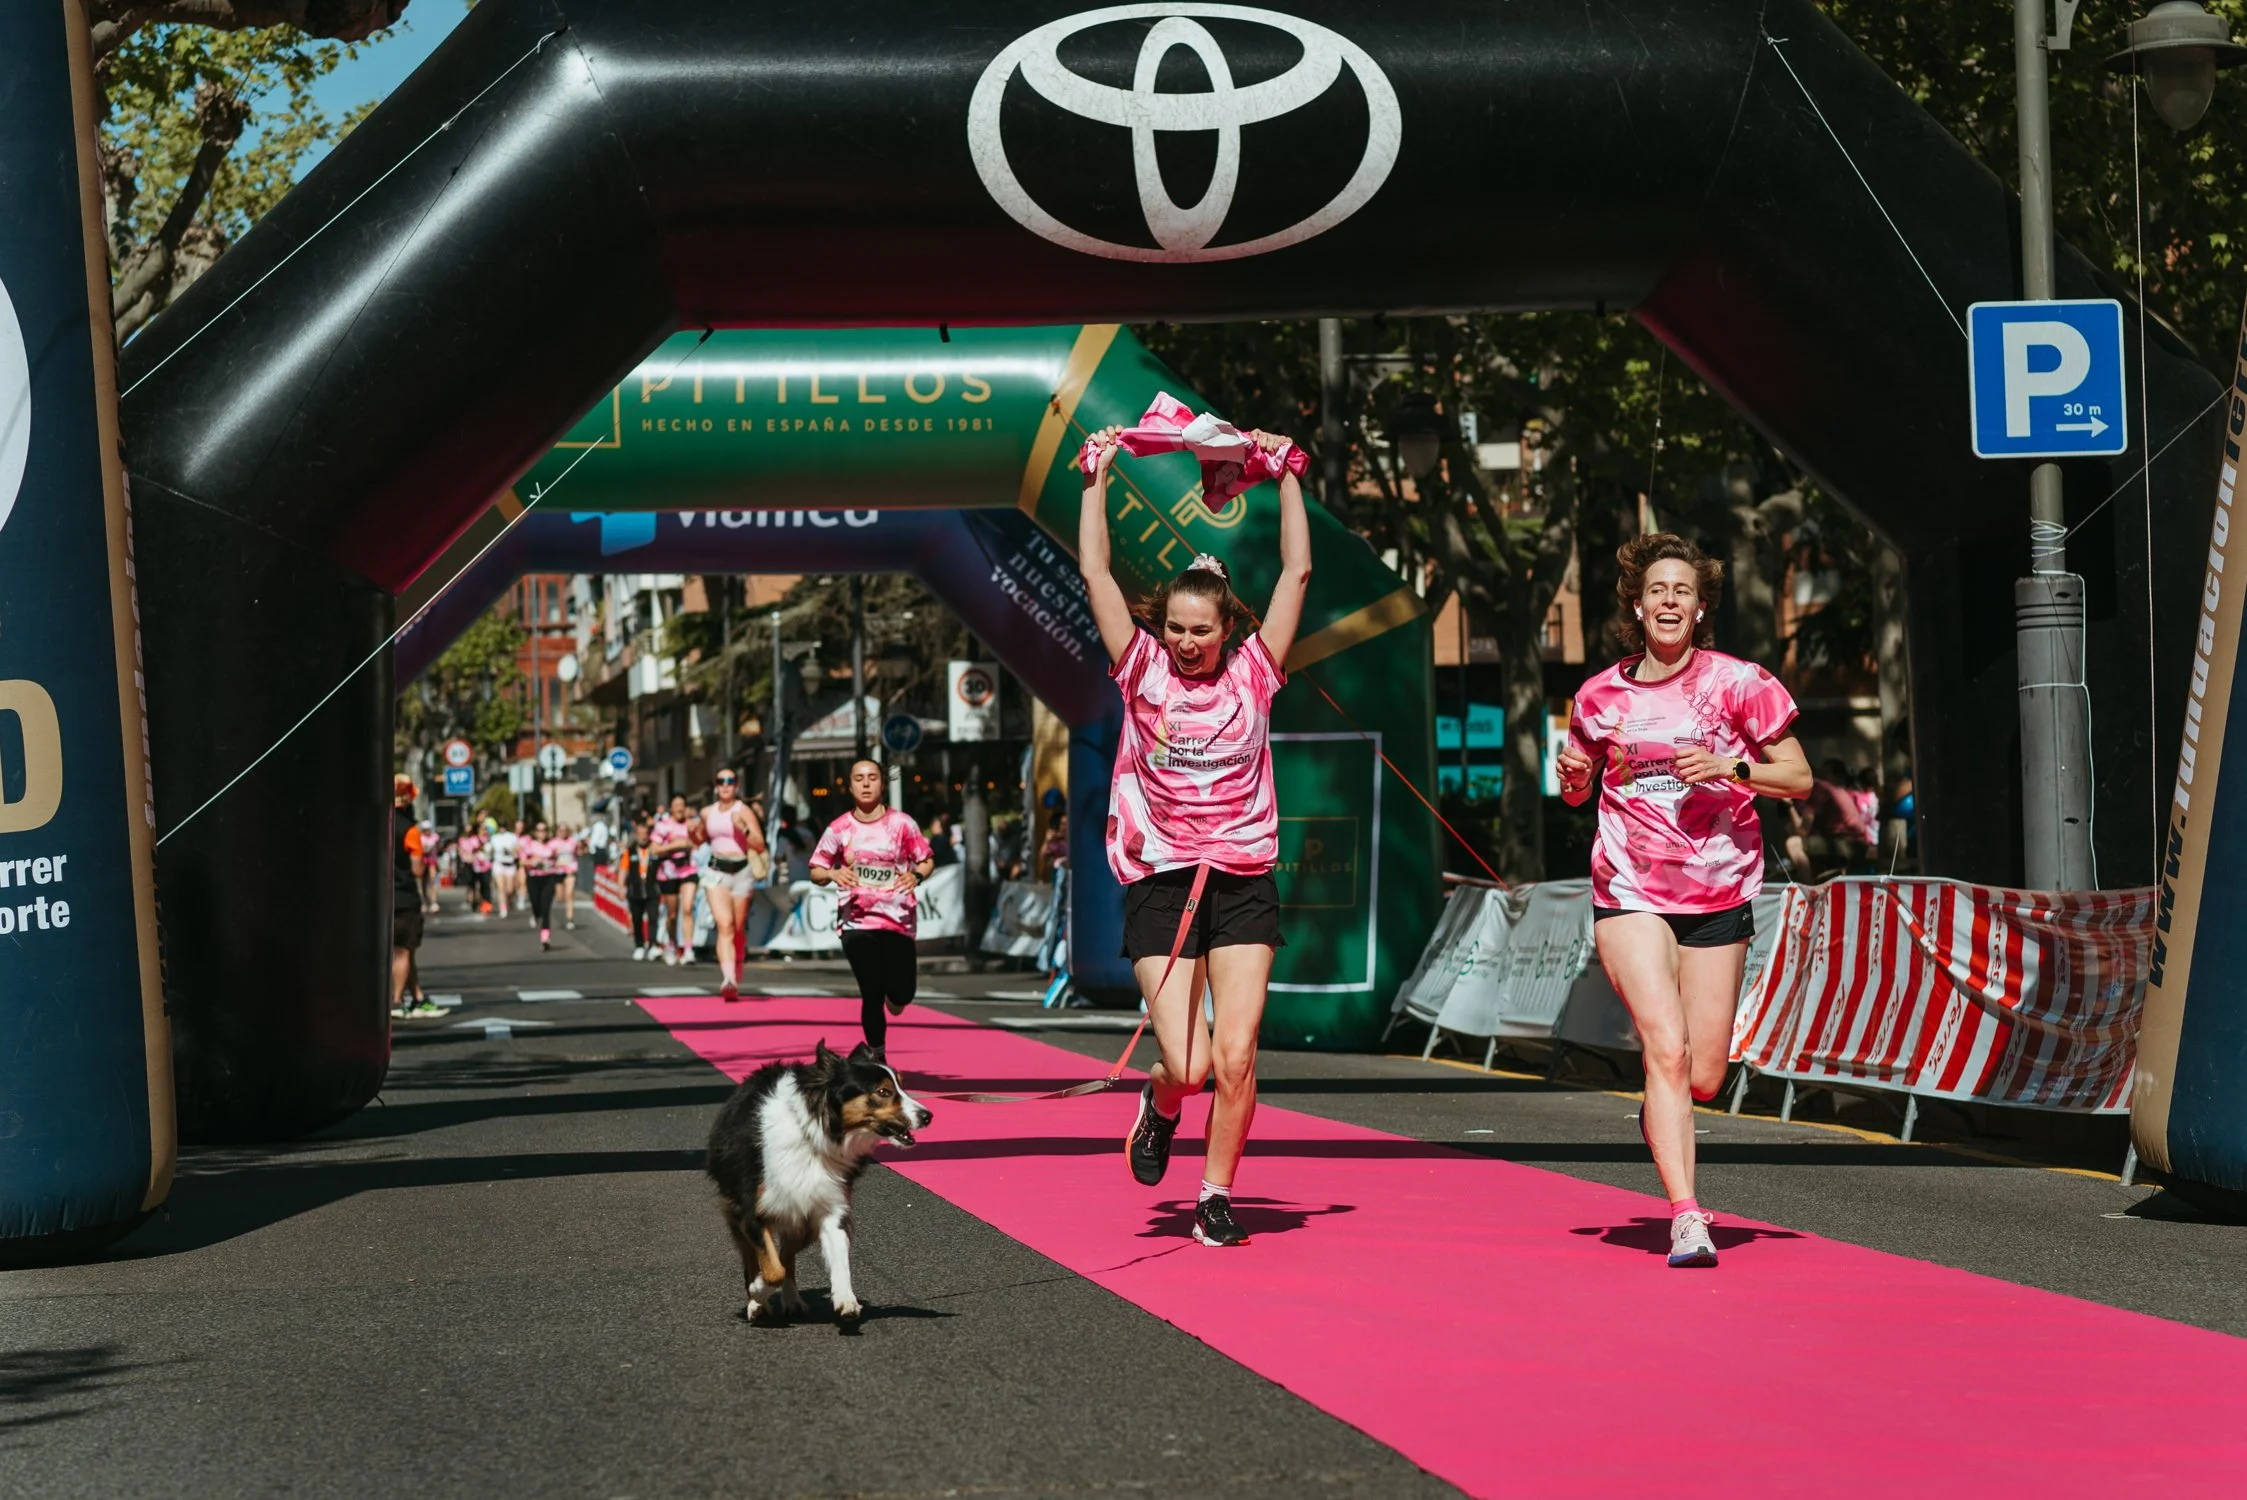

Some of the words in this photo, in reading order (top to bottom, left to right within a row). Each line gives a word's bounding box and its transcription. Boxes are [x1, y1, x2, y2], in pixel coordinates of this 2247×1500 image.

[2002, 320, 2091, 438] P
[2063, 403, 2084, 416] 30
[2089, 405, 2102, 416] m
[641, 418, 713, 432] HECHO
[727, 418, 753, 432] EN
[767, 416, 850, 432] ESPAÑA
[864, 418, 934, 432] DESDE
[946, 418, 993, 432] 1981
[1025, 530, 1056, 565] Tu
[990, 564, 1084, 662] vocación.
[963, 679, 986, 695] 30
[1169, 721, 1183, 733] XI
[1169, 745, 1191, 759] por
[1192, 747, 1204, 757] la
[1625, 743, 1638, 756] XI
[1168, 753, 1251, 770] Investigación
[1655, 768, 1669, 776] la
[856, 866, 892, 882] 10929
